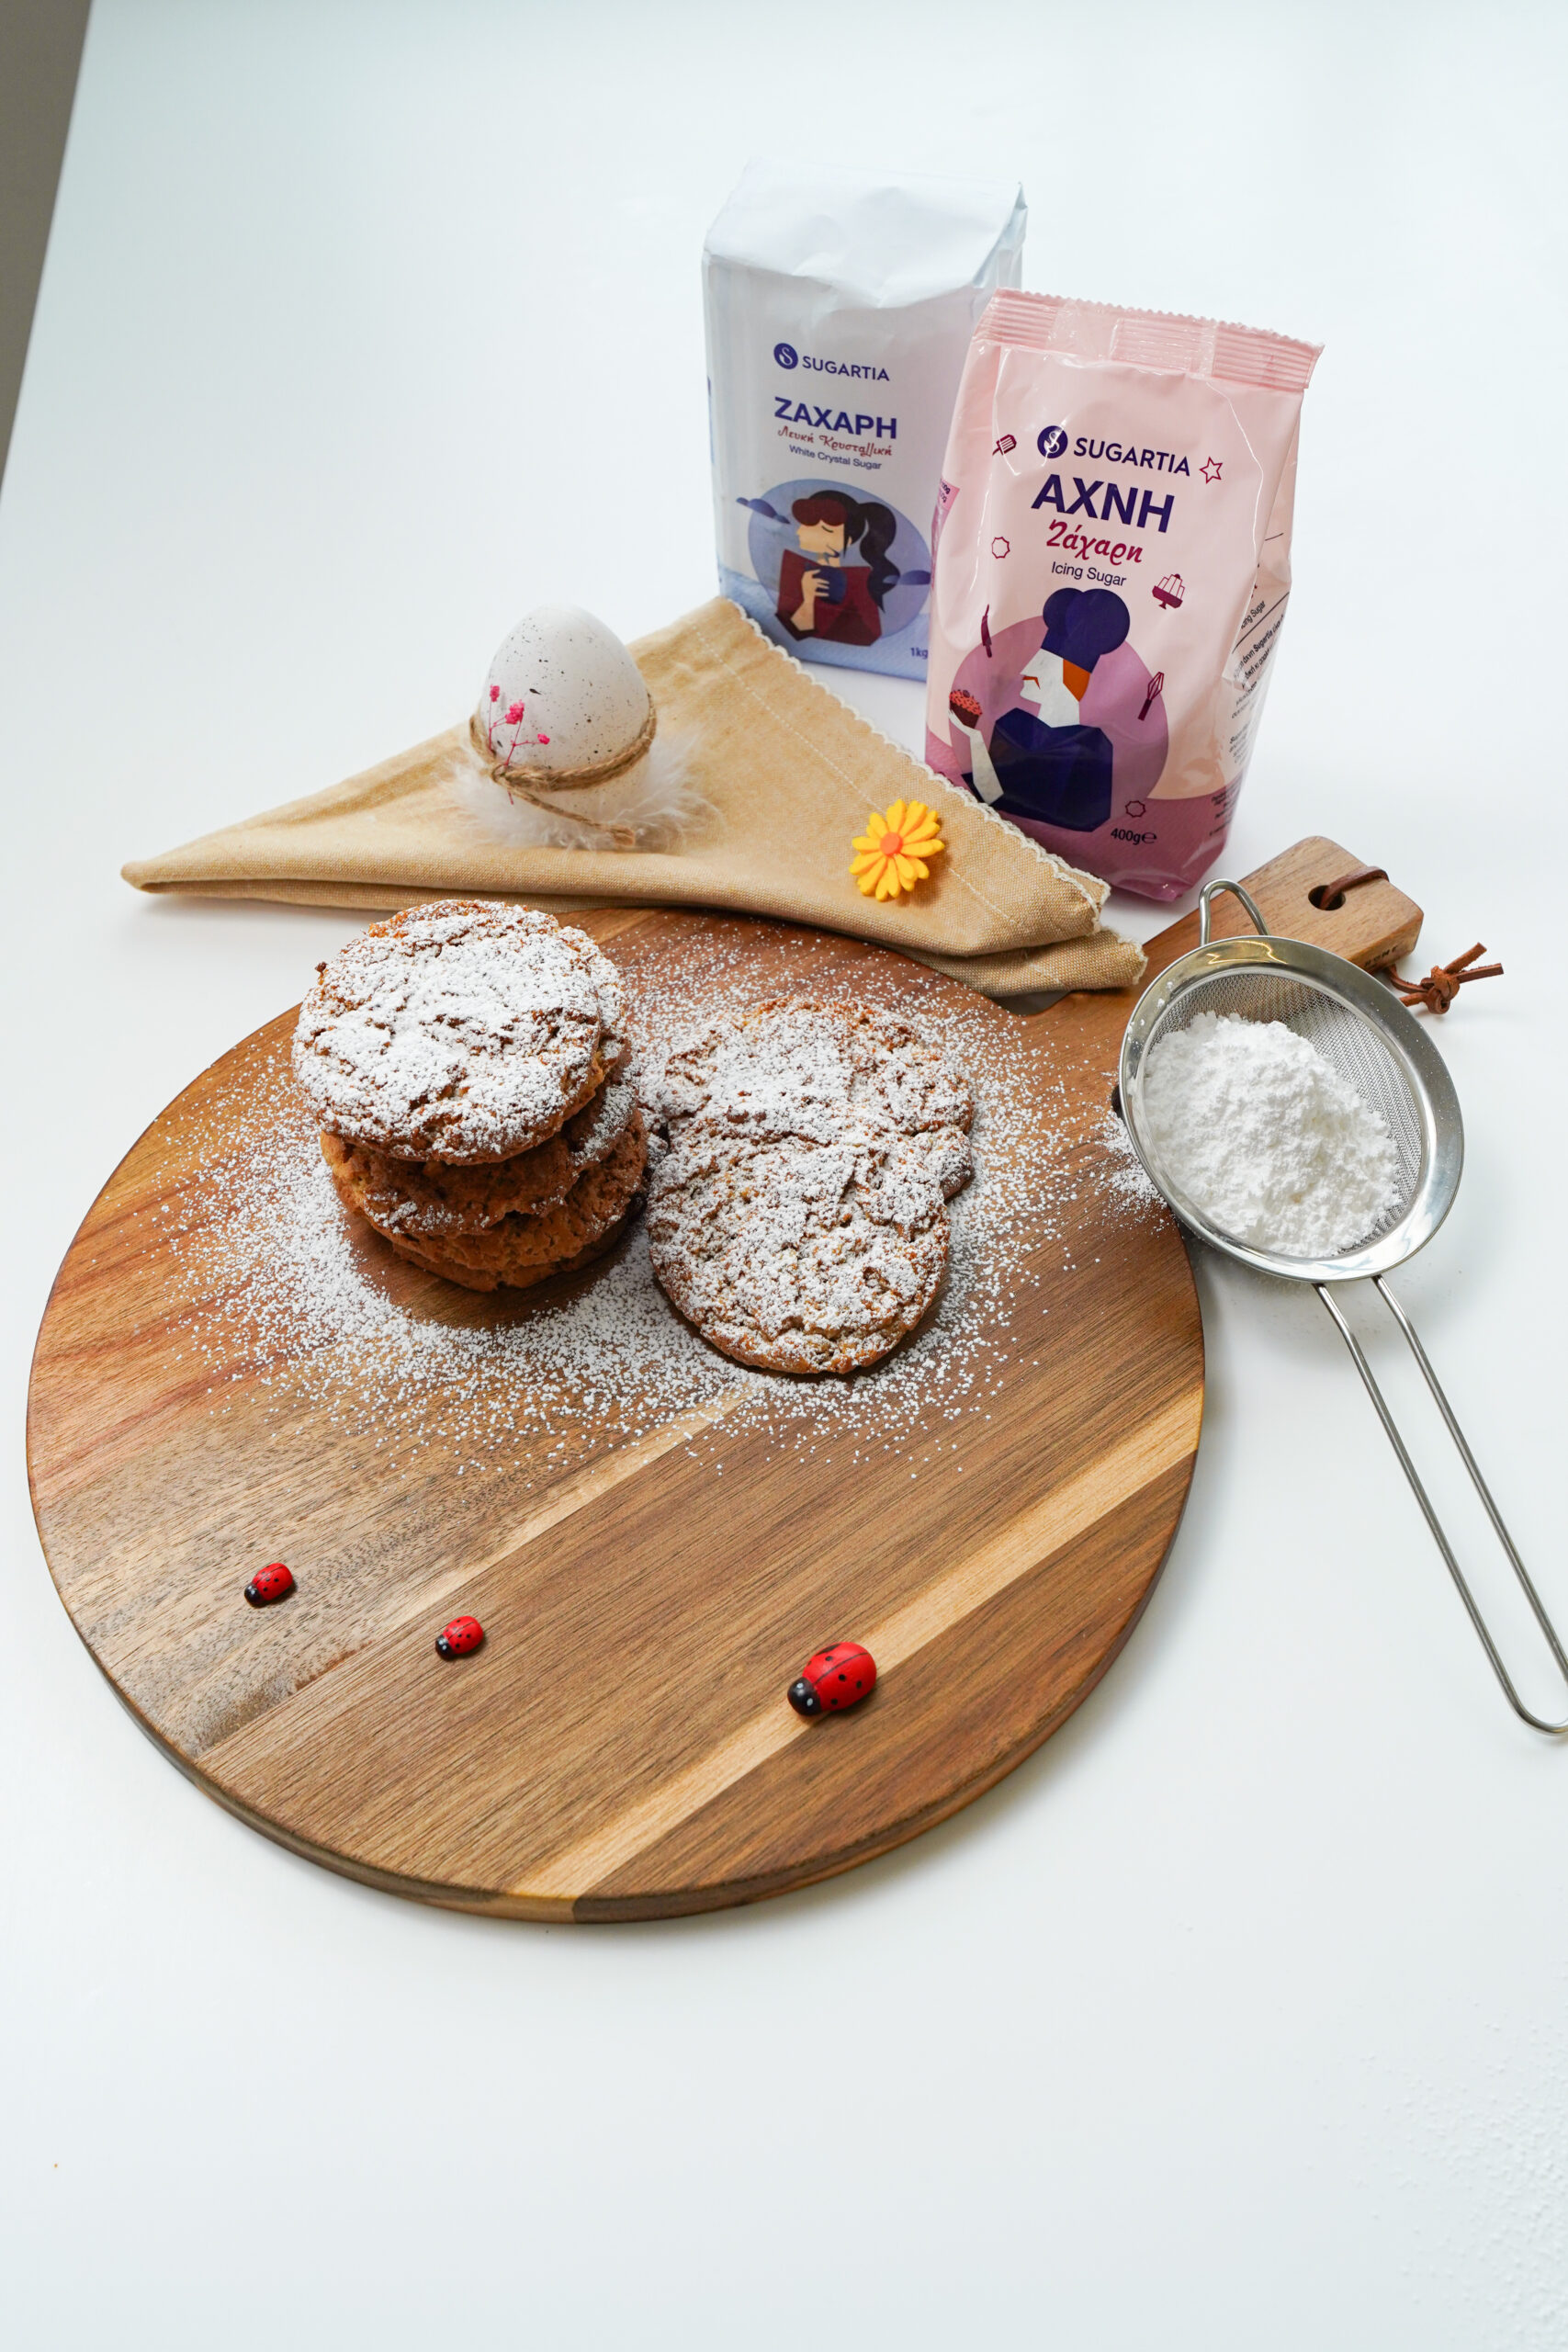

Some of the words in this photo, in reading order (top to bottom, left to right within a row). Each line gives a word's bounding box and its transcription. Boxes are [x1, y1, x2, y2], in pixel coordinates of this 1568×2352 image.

[802, 356, 890, 381] SUGARTIA
[774, 396, 897, 440] ΖΑΧΑΡΗ
[777, 425, 815, 444] Λευκή
[789, 444, 816, 458] White
[818, 451, 851, 466] Crystal
[853, 458, 883, 470] Sugar
[1073, 437, 1190, 477] SUGARTIA
[1031, 473, 1175, 534] ΑΧΝΗ
[1046, 519, 1144, 566] Ζάχαρη
[1051, 561, 1083, 581] Icing
[1087, 567, 1127, 587] Sugar
[1250, 600, 1266, 617] Sugar
